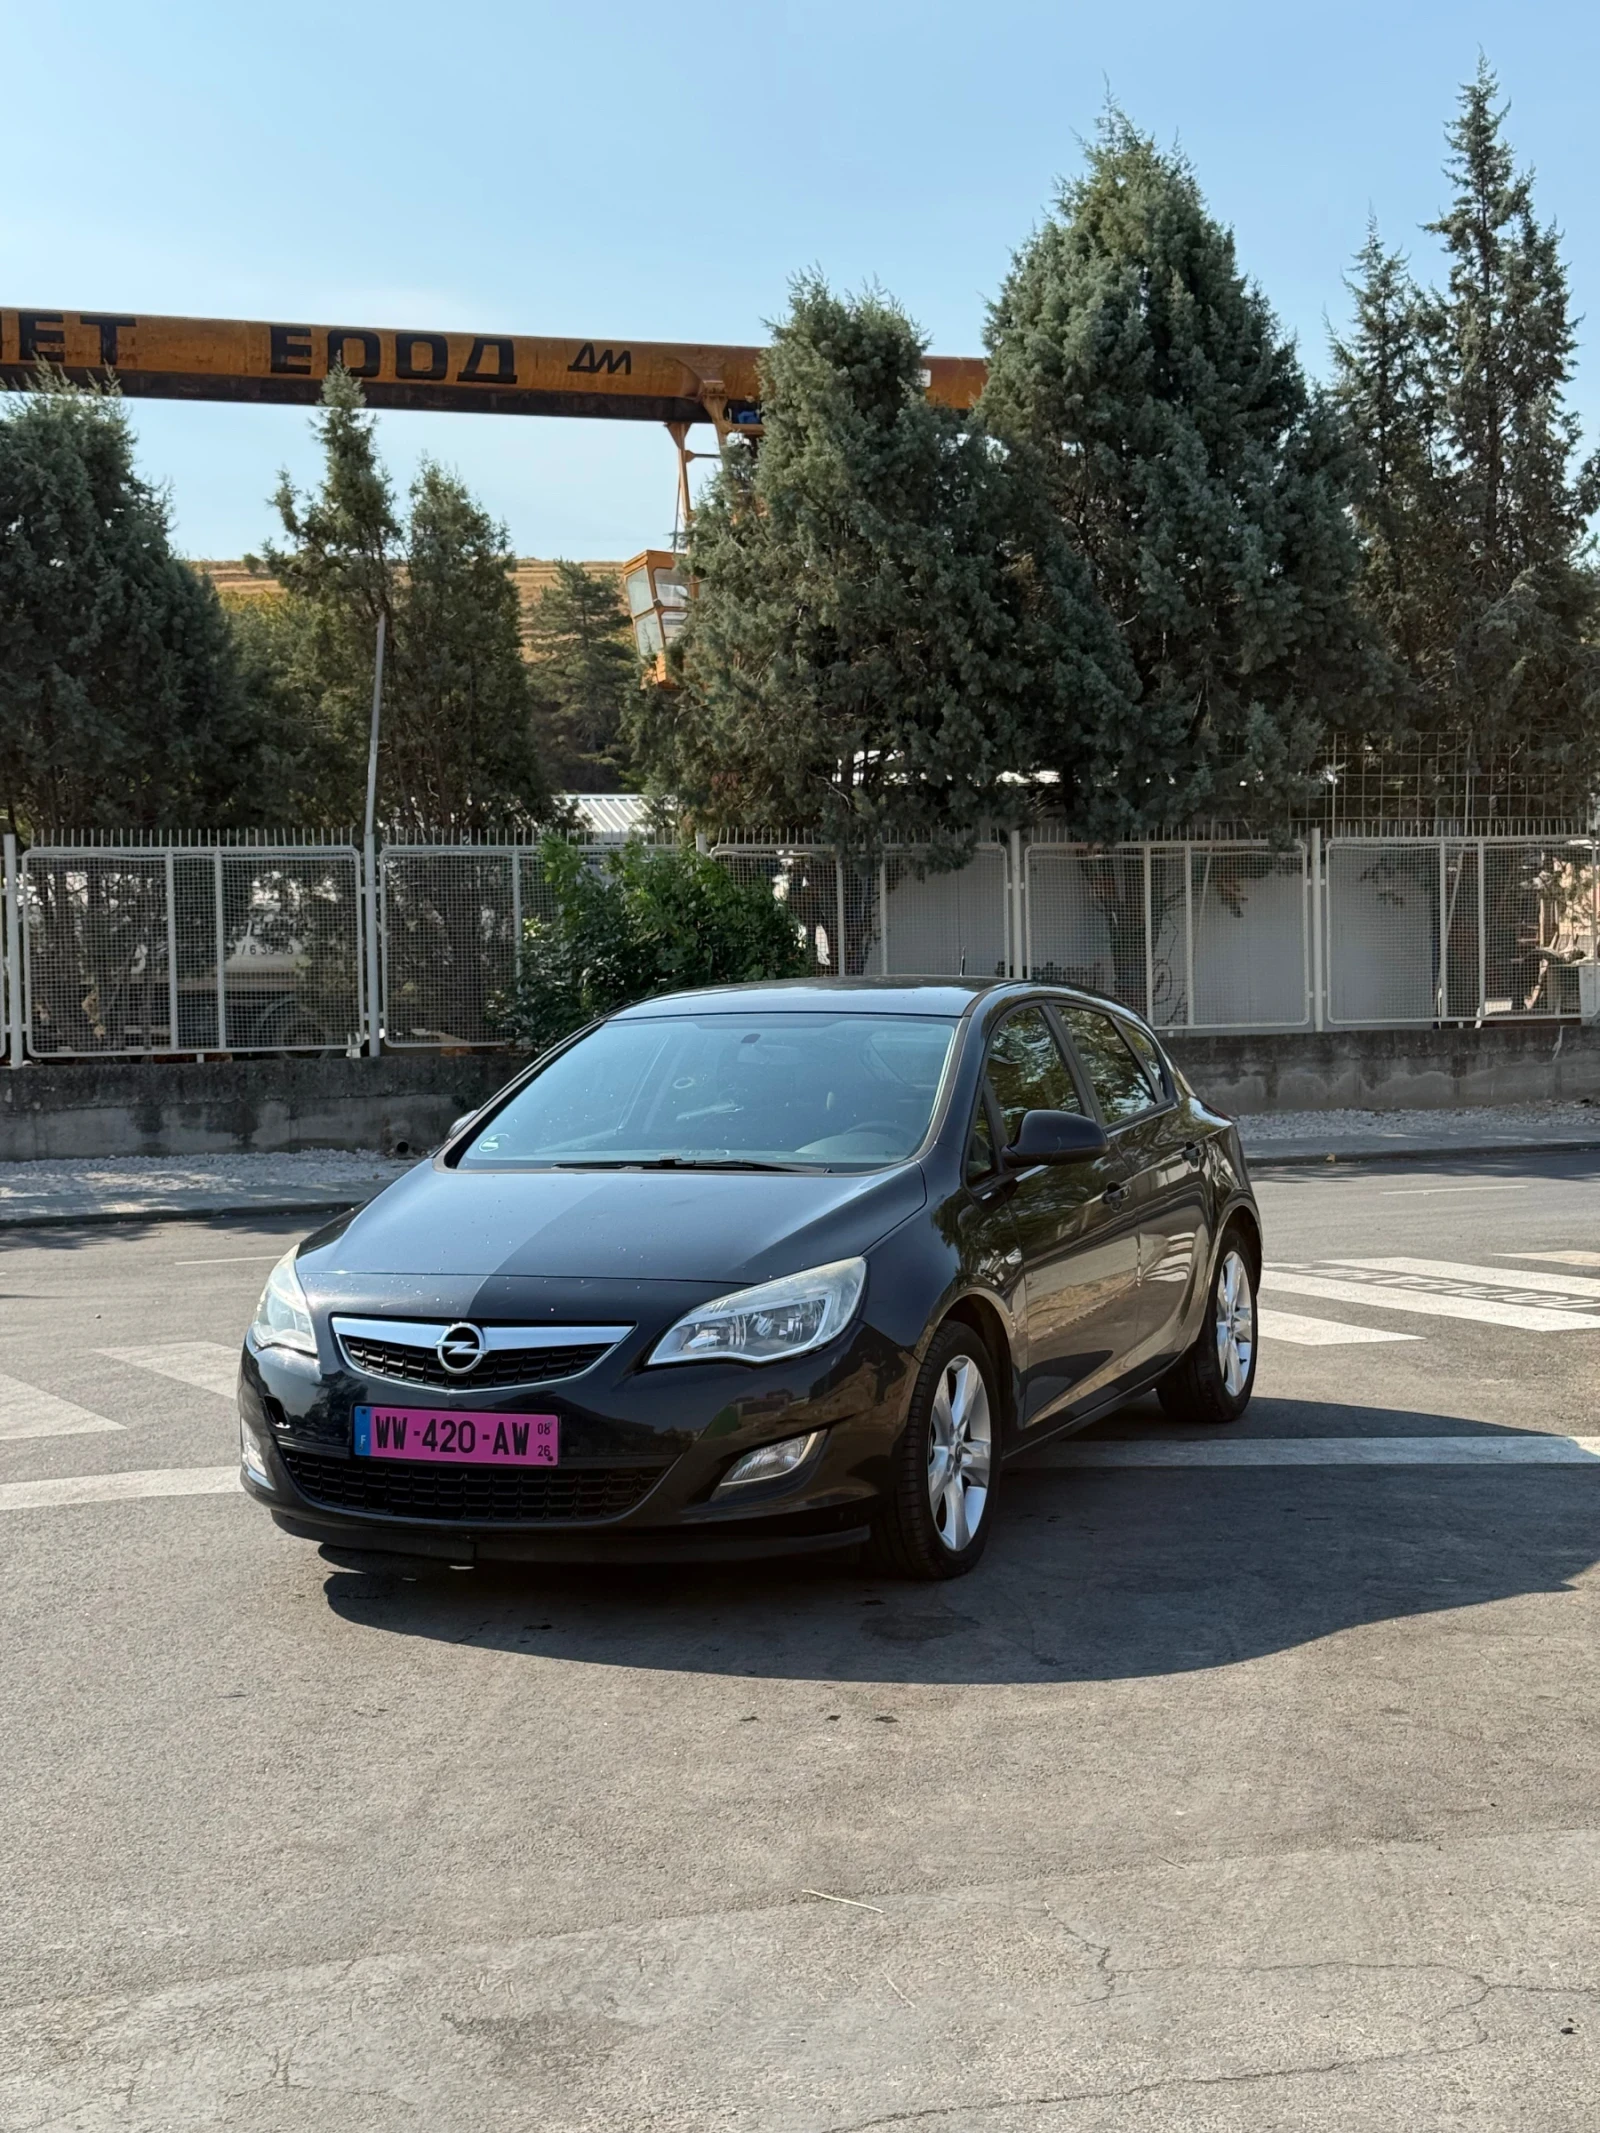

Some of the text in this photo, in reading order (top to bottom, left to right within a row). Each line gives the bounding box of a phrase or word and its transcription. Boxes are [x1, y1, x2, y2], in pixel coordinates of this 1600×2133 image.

[0, 311, 518, 384] ЕТ ЕООД
[375, 1415, 530, 1456] WW-420-AW
[537, 1422, 551, 1436] 08
[537, 1444, 551, 1457] 26
